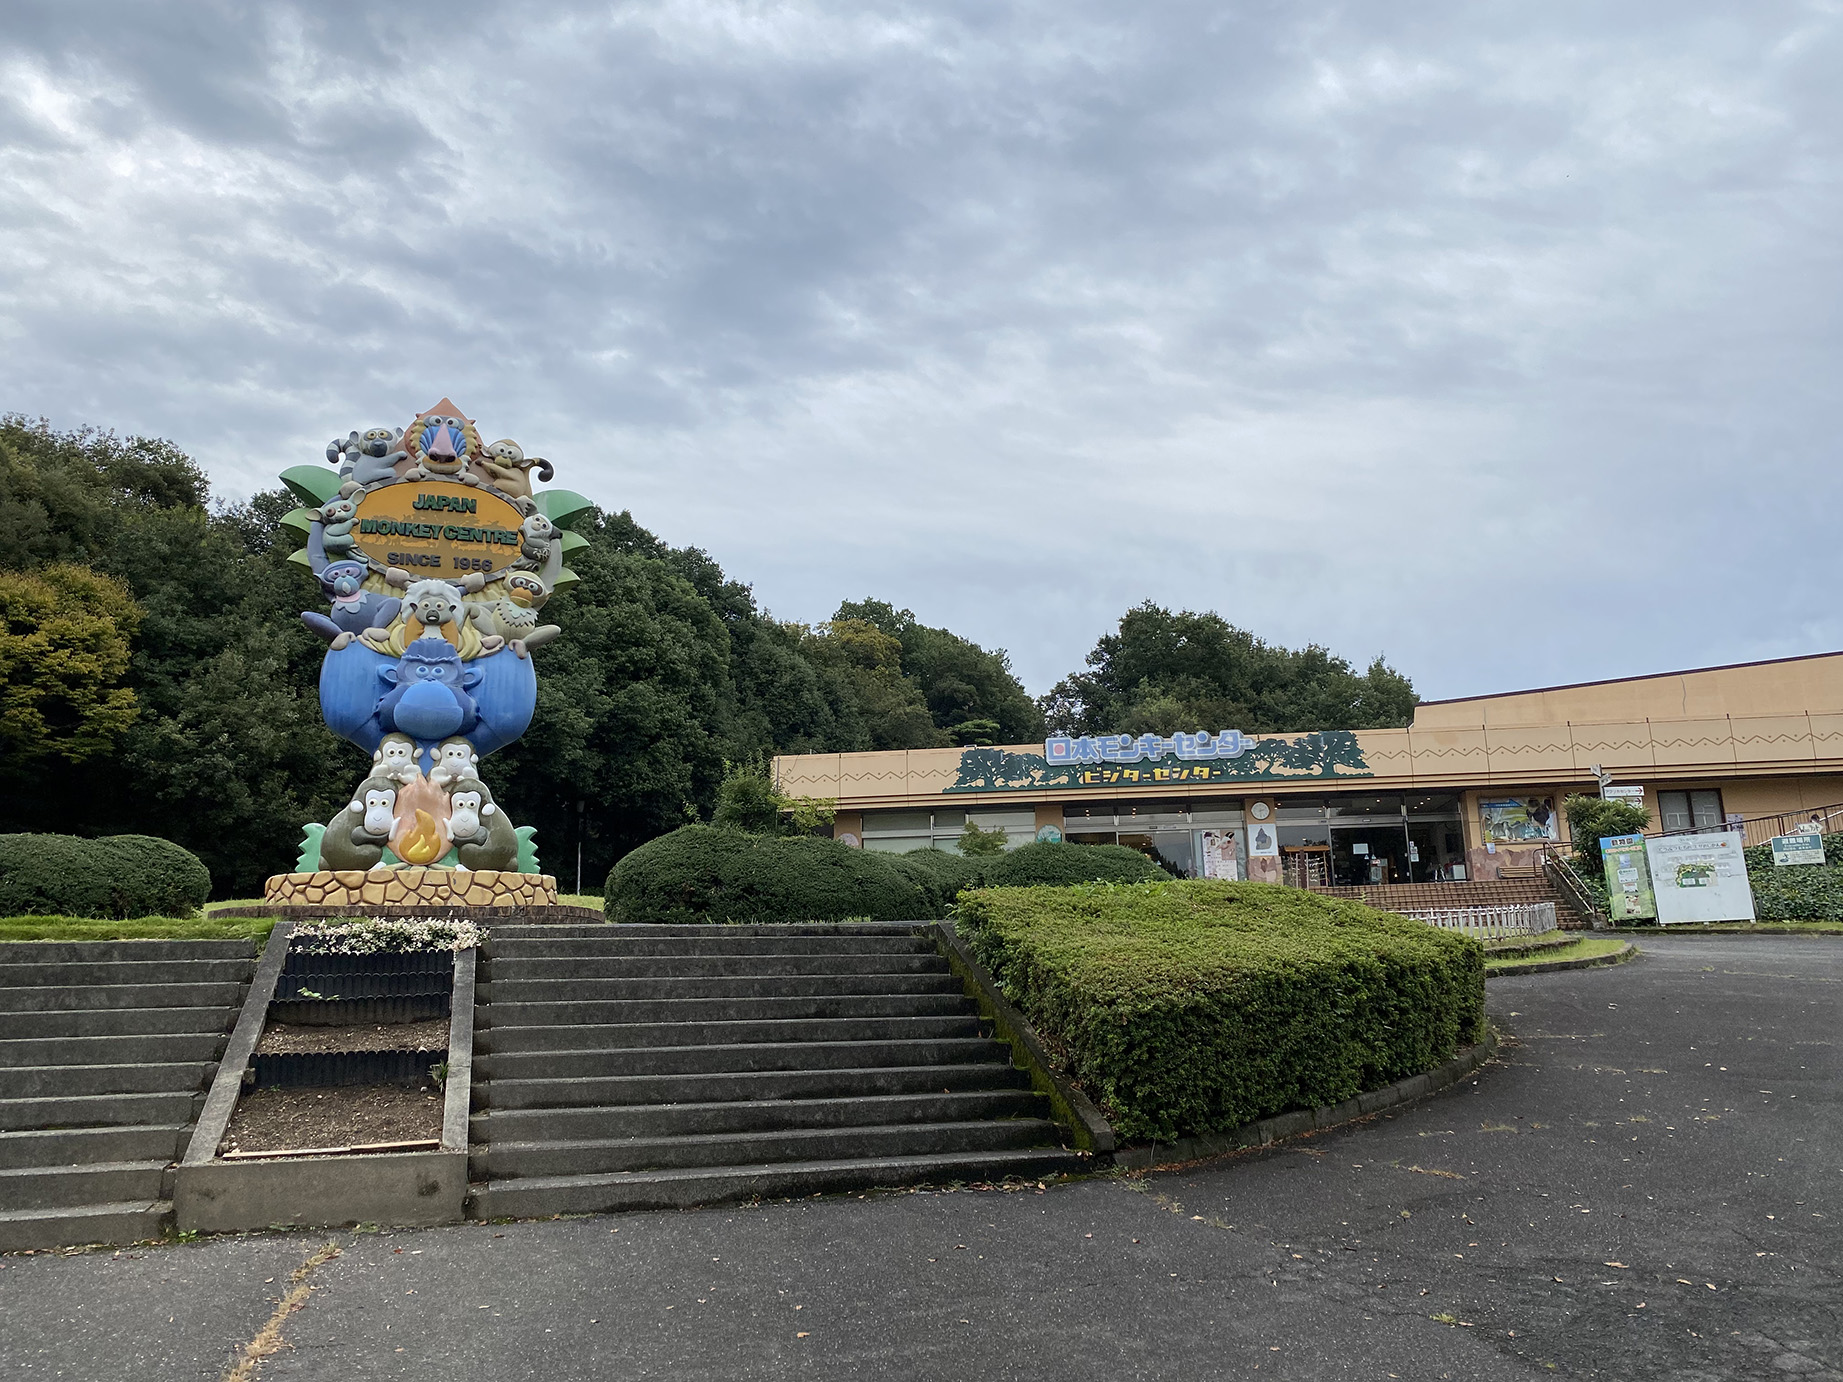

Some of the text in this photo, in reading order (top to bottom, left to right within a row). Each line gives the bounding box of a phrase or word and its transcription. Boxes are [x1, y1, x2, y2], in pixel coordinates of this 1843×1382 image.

[412, 493, 477, 514] JAPAN
[360, 518, 518, 546] MONKEY CENTRE
[387, 552, 493, 572] SINCE 1956
[1046, 730, 1257, 765] 日本モンキーセンター
[1083, 766, 1222, 784] ビジターセンター
